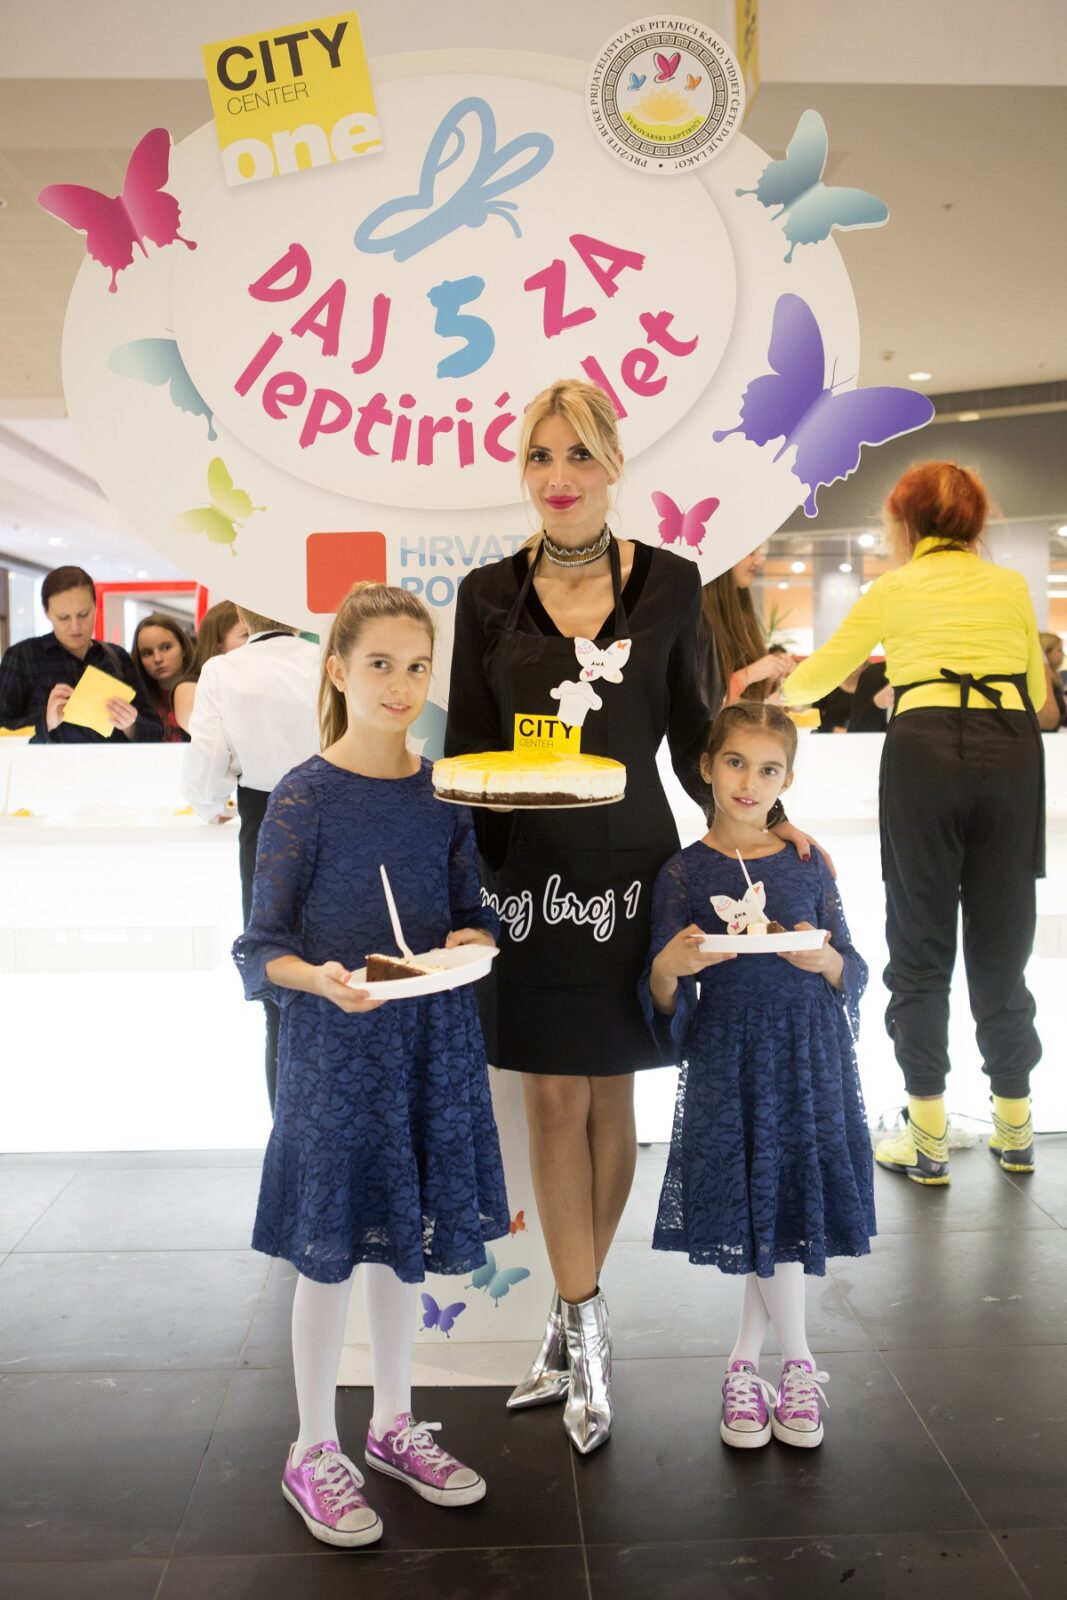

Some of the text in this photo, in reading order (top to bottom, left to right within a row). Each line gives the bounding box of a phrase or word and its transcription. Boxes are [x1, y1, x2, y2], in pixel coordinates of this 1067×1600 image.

[632, 24, 647, 36] NE
[649, 20, 698, 35] PITAJUĆI
[217, 21, 348, 91] CITY
[590, 32, 632, 106] PRIJATELJSTVA
[724, 57, 740, 96] VIDJET
[226, 81, 309, 115] CENTER
[591, 108, 609, 137] RUKE
[626, 115, 666, 141] VUKOVARSKI
[221, 112, 384, 186] one
[605, 137, 648, 168] PRUŽITE
[248, 233, 646, 379] DAJ 5 ZA
[234, 332, 531, 468] leptirić
[400, 575, 465, 607] PO
[519, 718, 573, 739] CITY
[519, 738, 554, 748] CENTER
[543, 874, 616, 942] broj
[623, 880, 642, 919] 1
